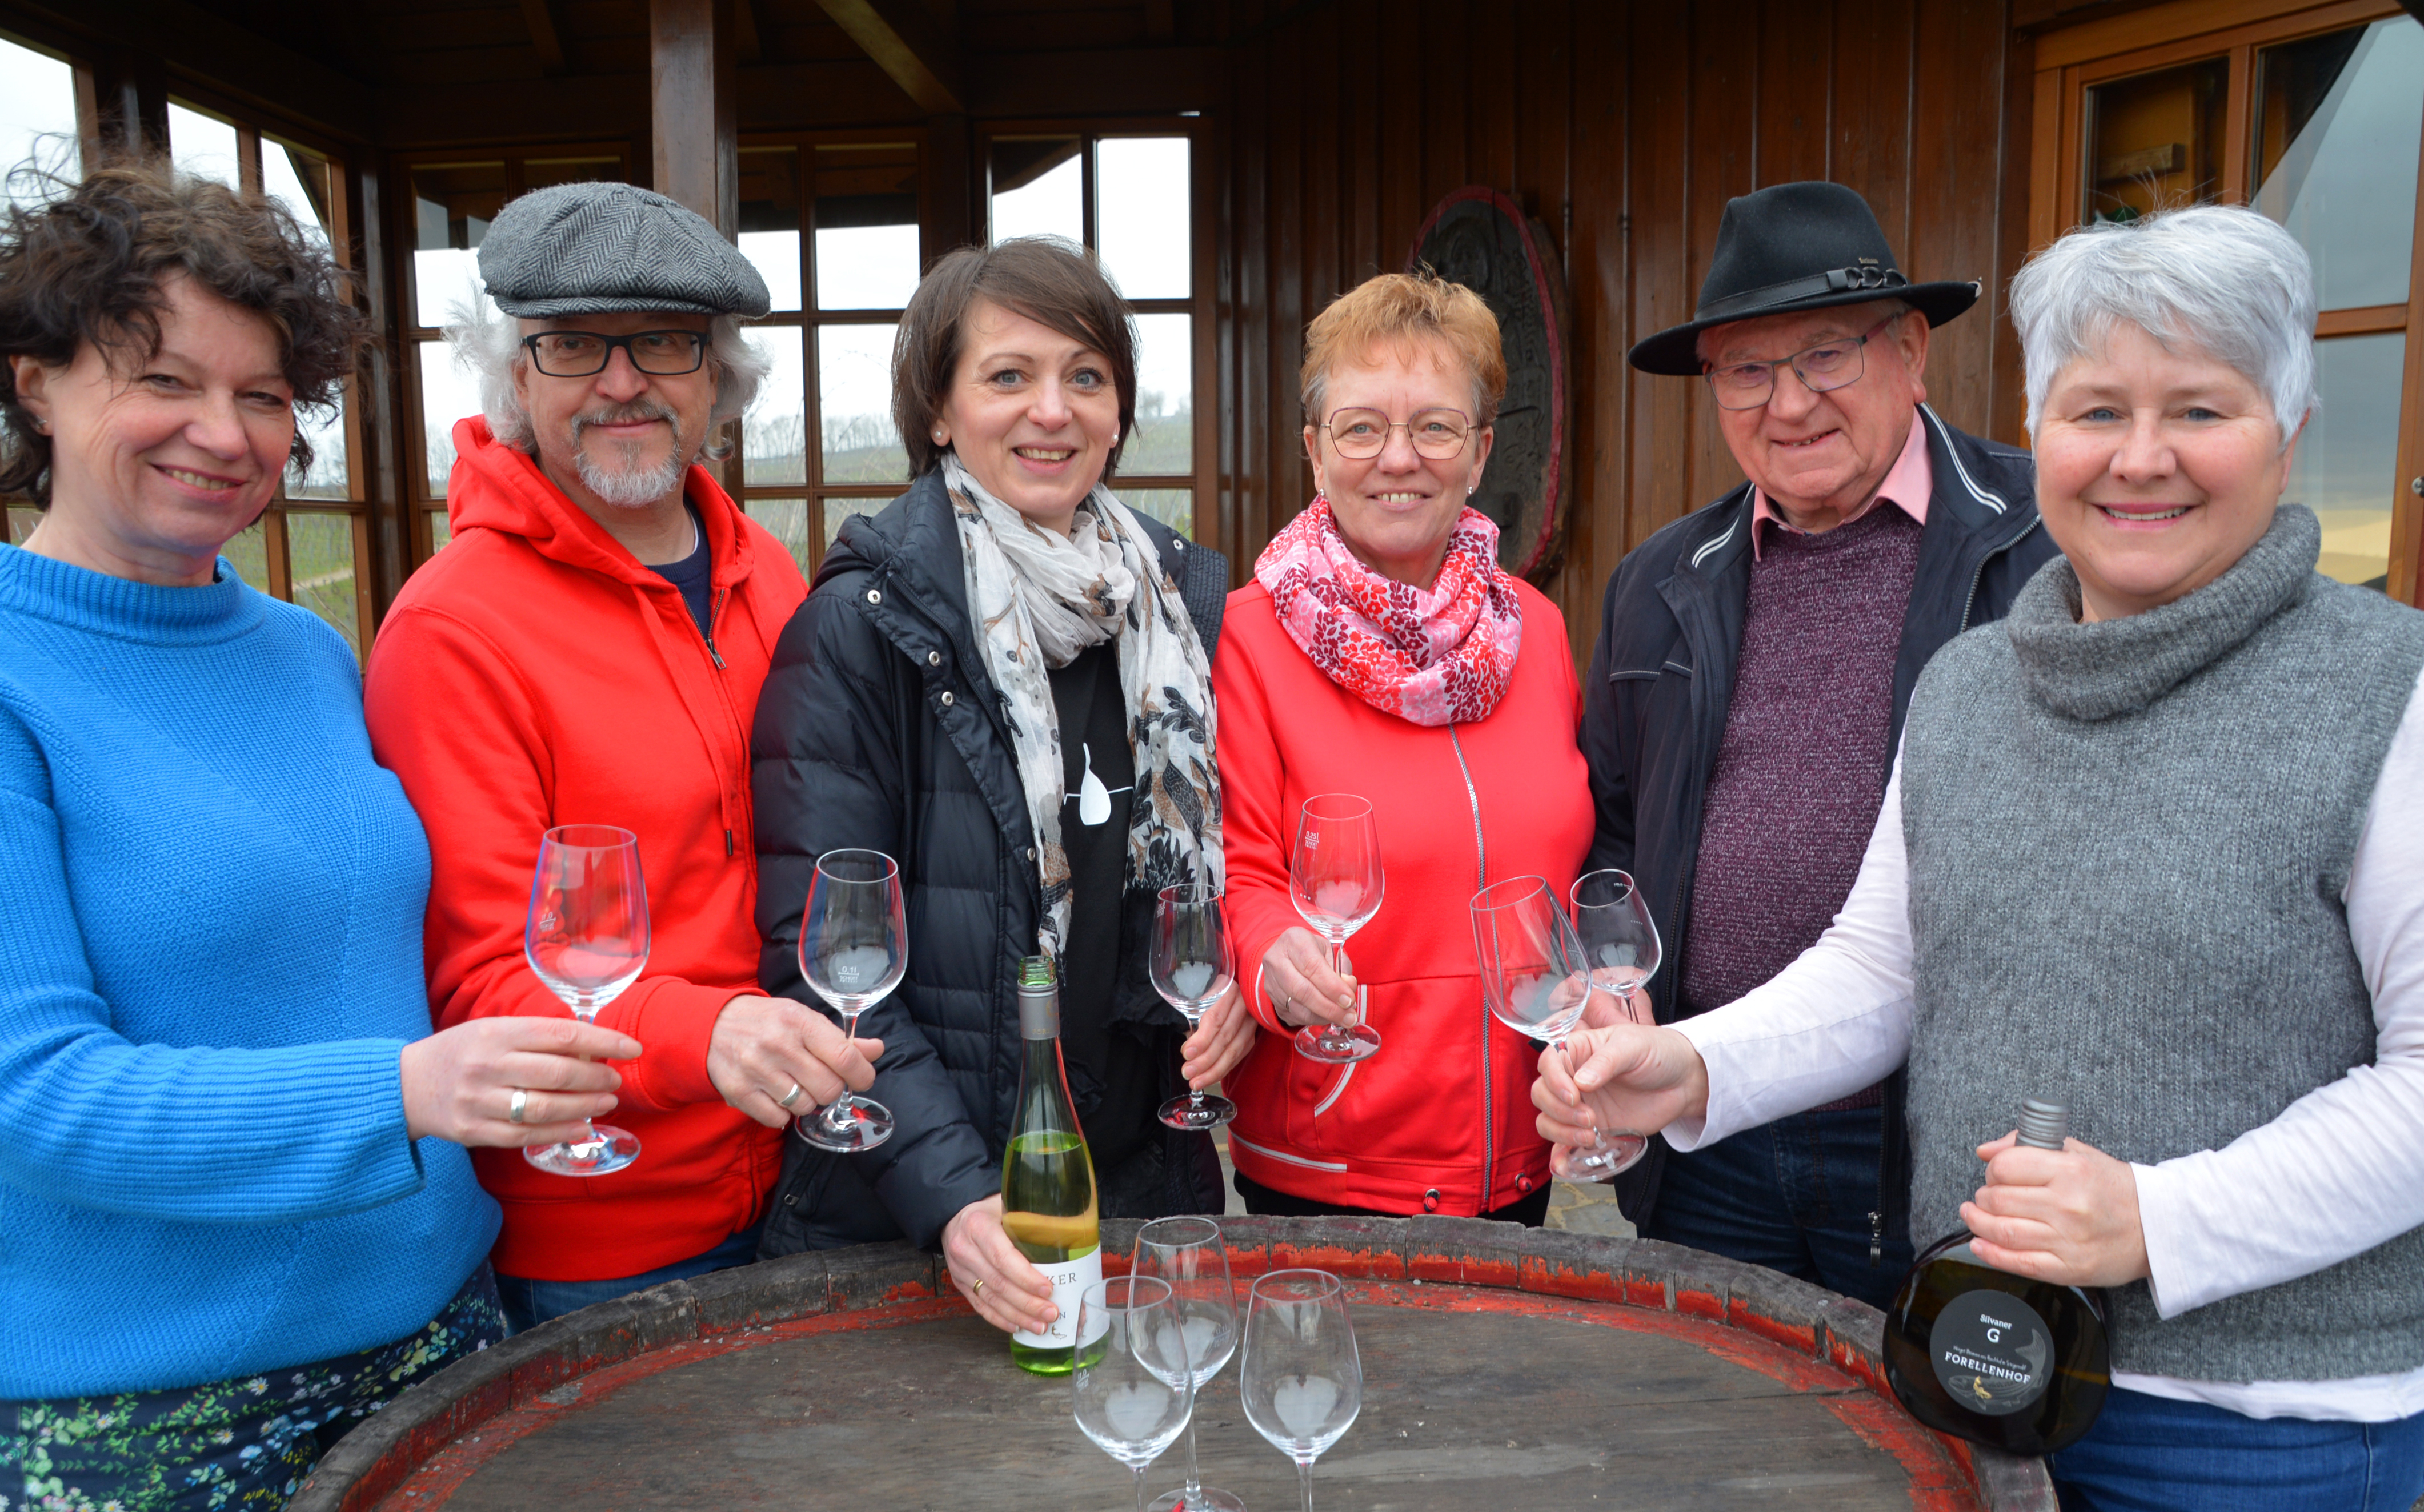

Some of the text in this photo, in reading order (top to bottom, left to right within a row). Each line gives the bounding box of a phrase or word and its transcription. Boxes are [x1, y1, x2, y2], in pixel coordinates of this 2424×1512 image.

[1980, 1314, 2012, 1330] Silvaner
[1987, 1328, 2000, 1343] G
[1945, 1351, 2030, 1384] FORELLENHOF
